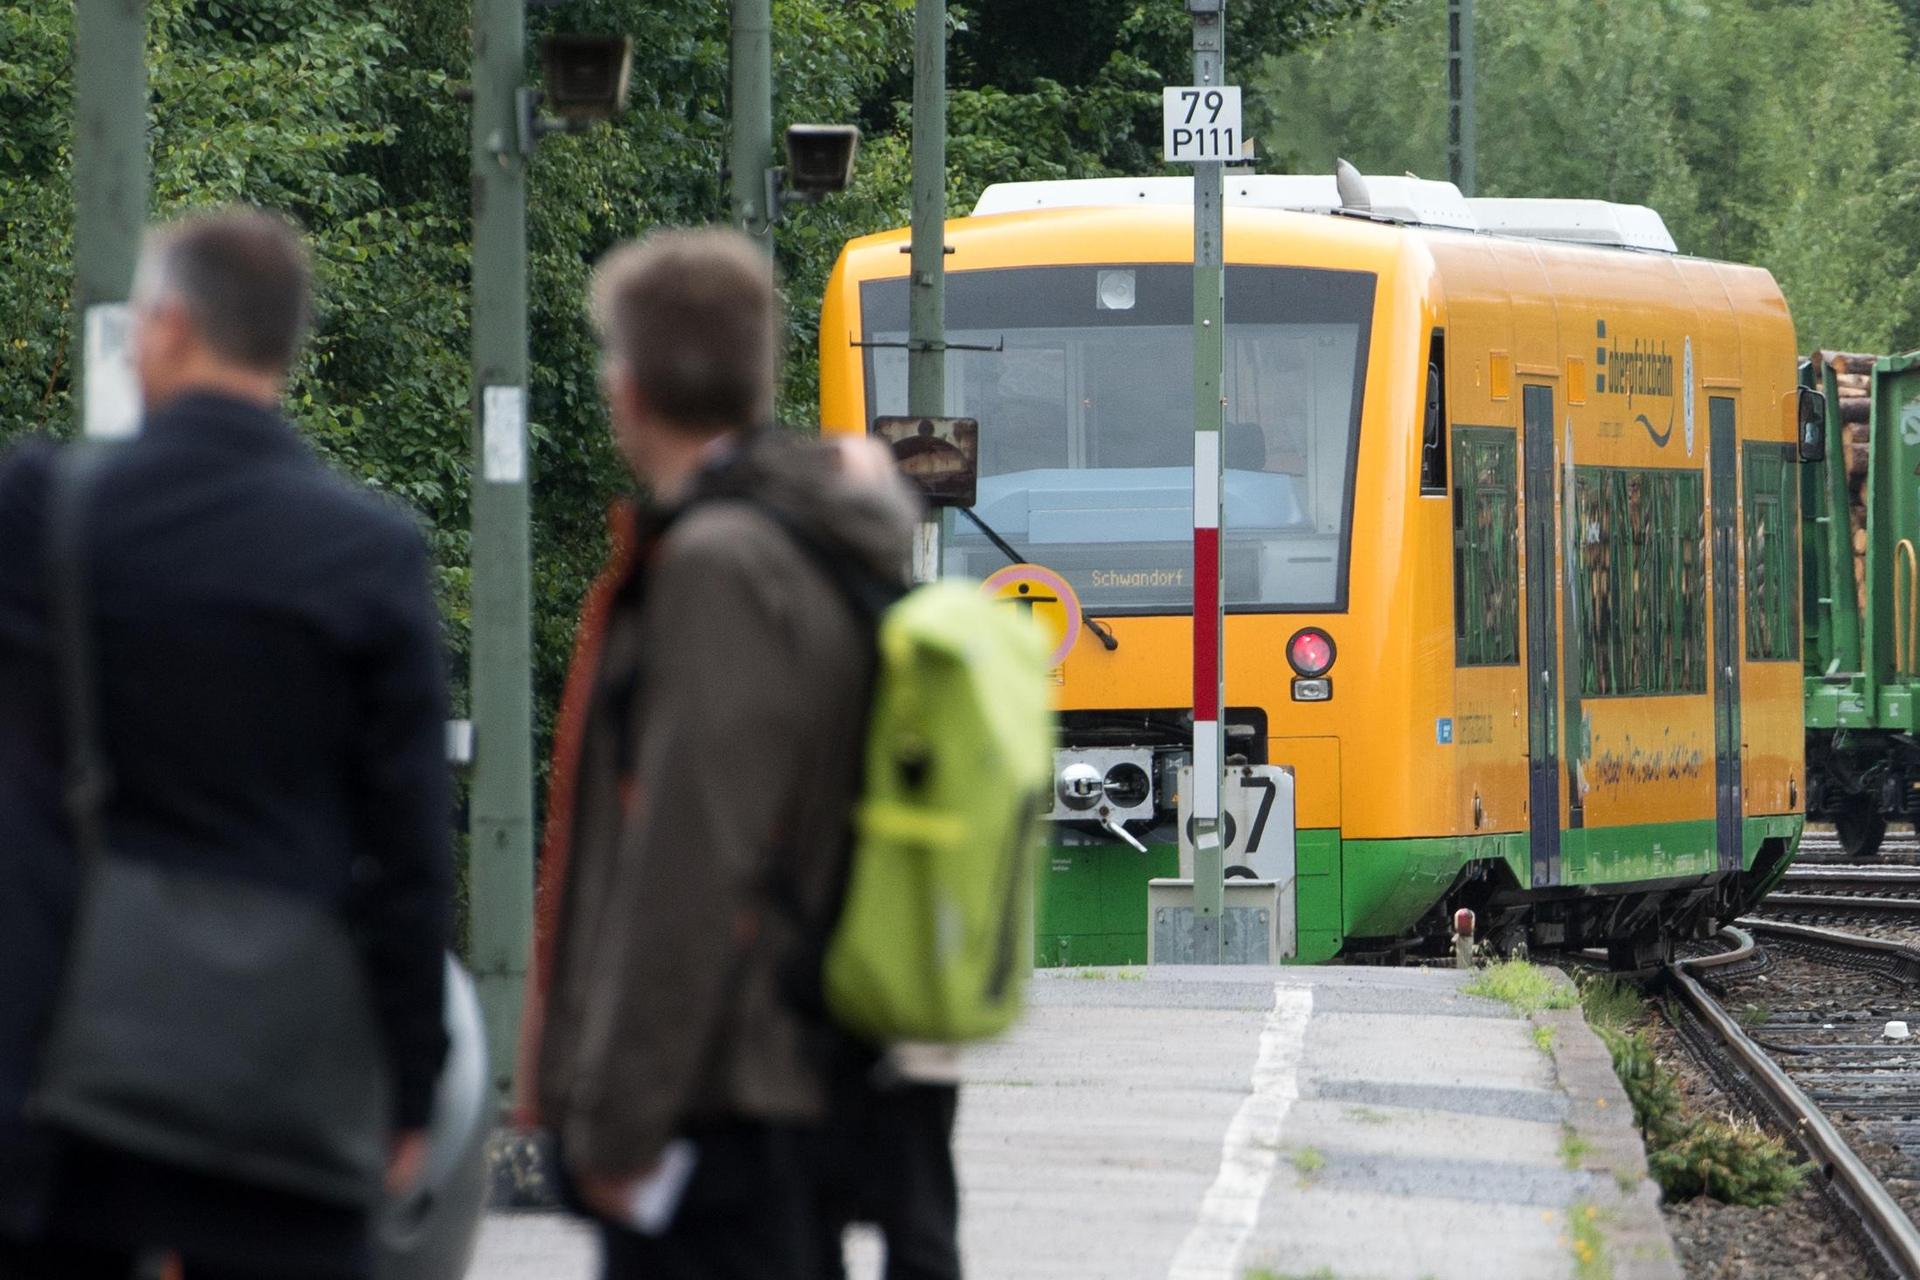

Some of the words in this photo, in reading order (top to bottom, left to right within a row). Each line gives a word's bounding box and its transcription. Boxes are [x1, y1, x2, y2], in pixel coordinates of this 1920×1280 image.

[1181, 91, 1223, 124] 79
[1173, 128, 1233, 156] P111
[1608, 335, 1674, 410] oberpfalzbahn
[1091, 568, 1184, 587] Schwandorf
